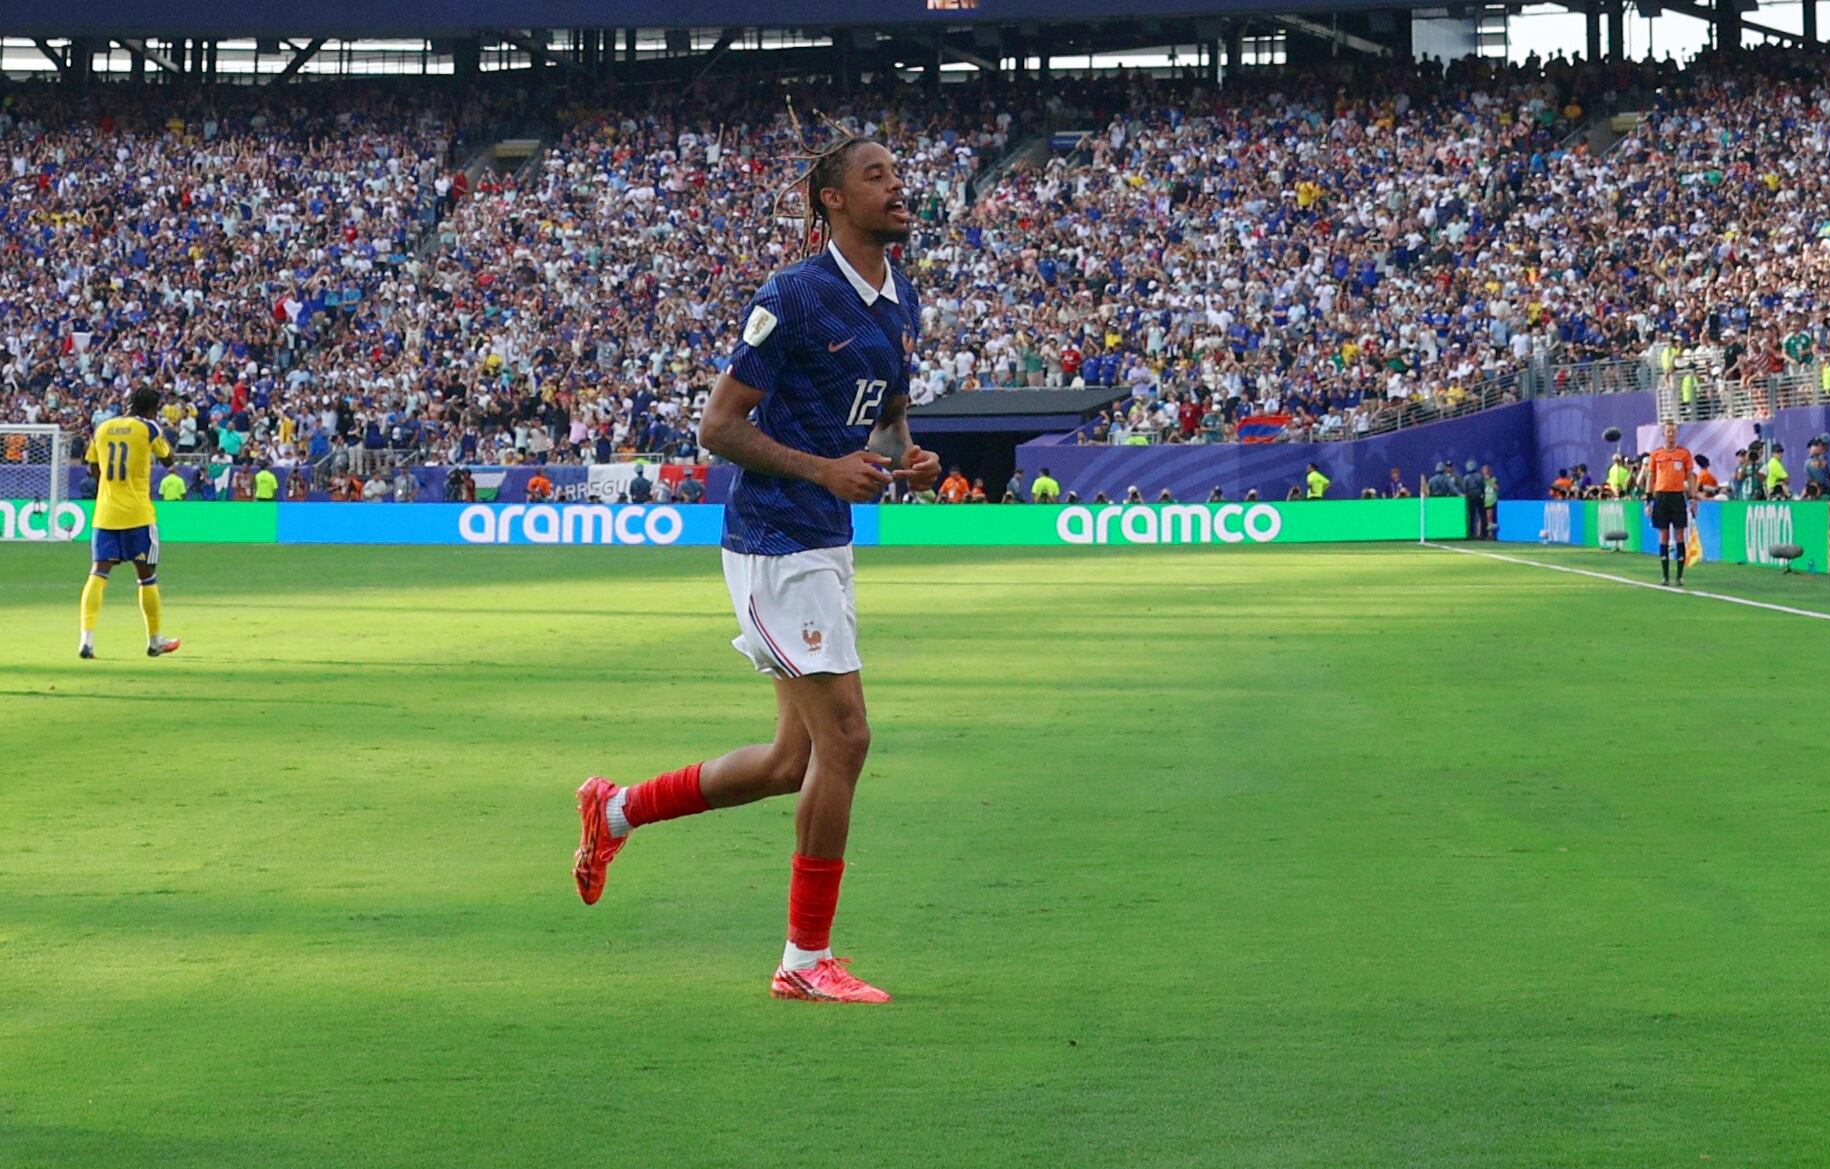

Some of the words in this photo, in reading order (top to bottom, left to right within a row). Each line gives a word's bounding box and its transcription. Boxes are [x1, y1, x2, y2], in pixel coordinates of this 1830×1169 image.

[846, 378, 888, 427] 12
[106, 441, 128, 481] 11
[458, 504, 683, 545] aramco
[1057, 503, 1282, 544] aramco
